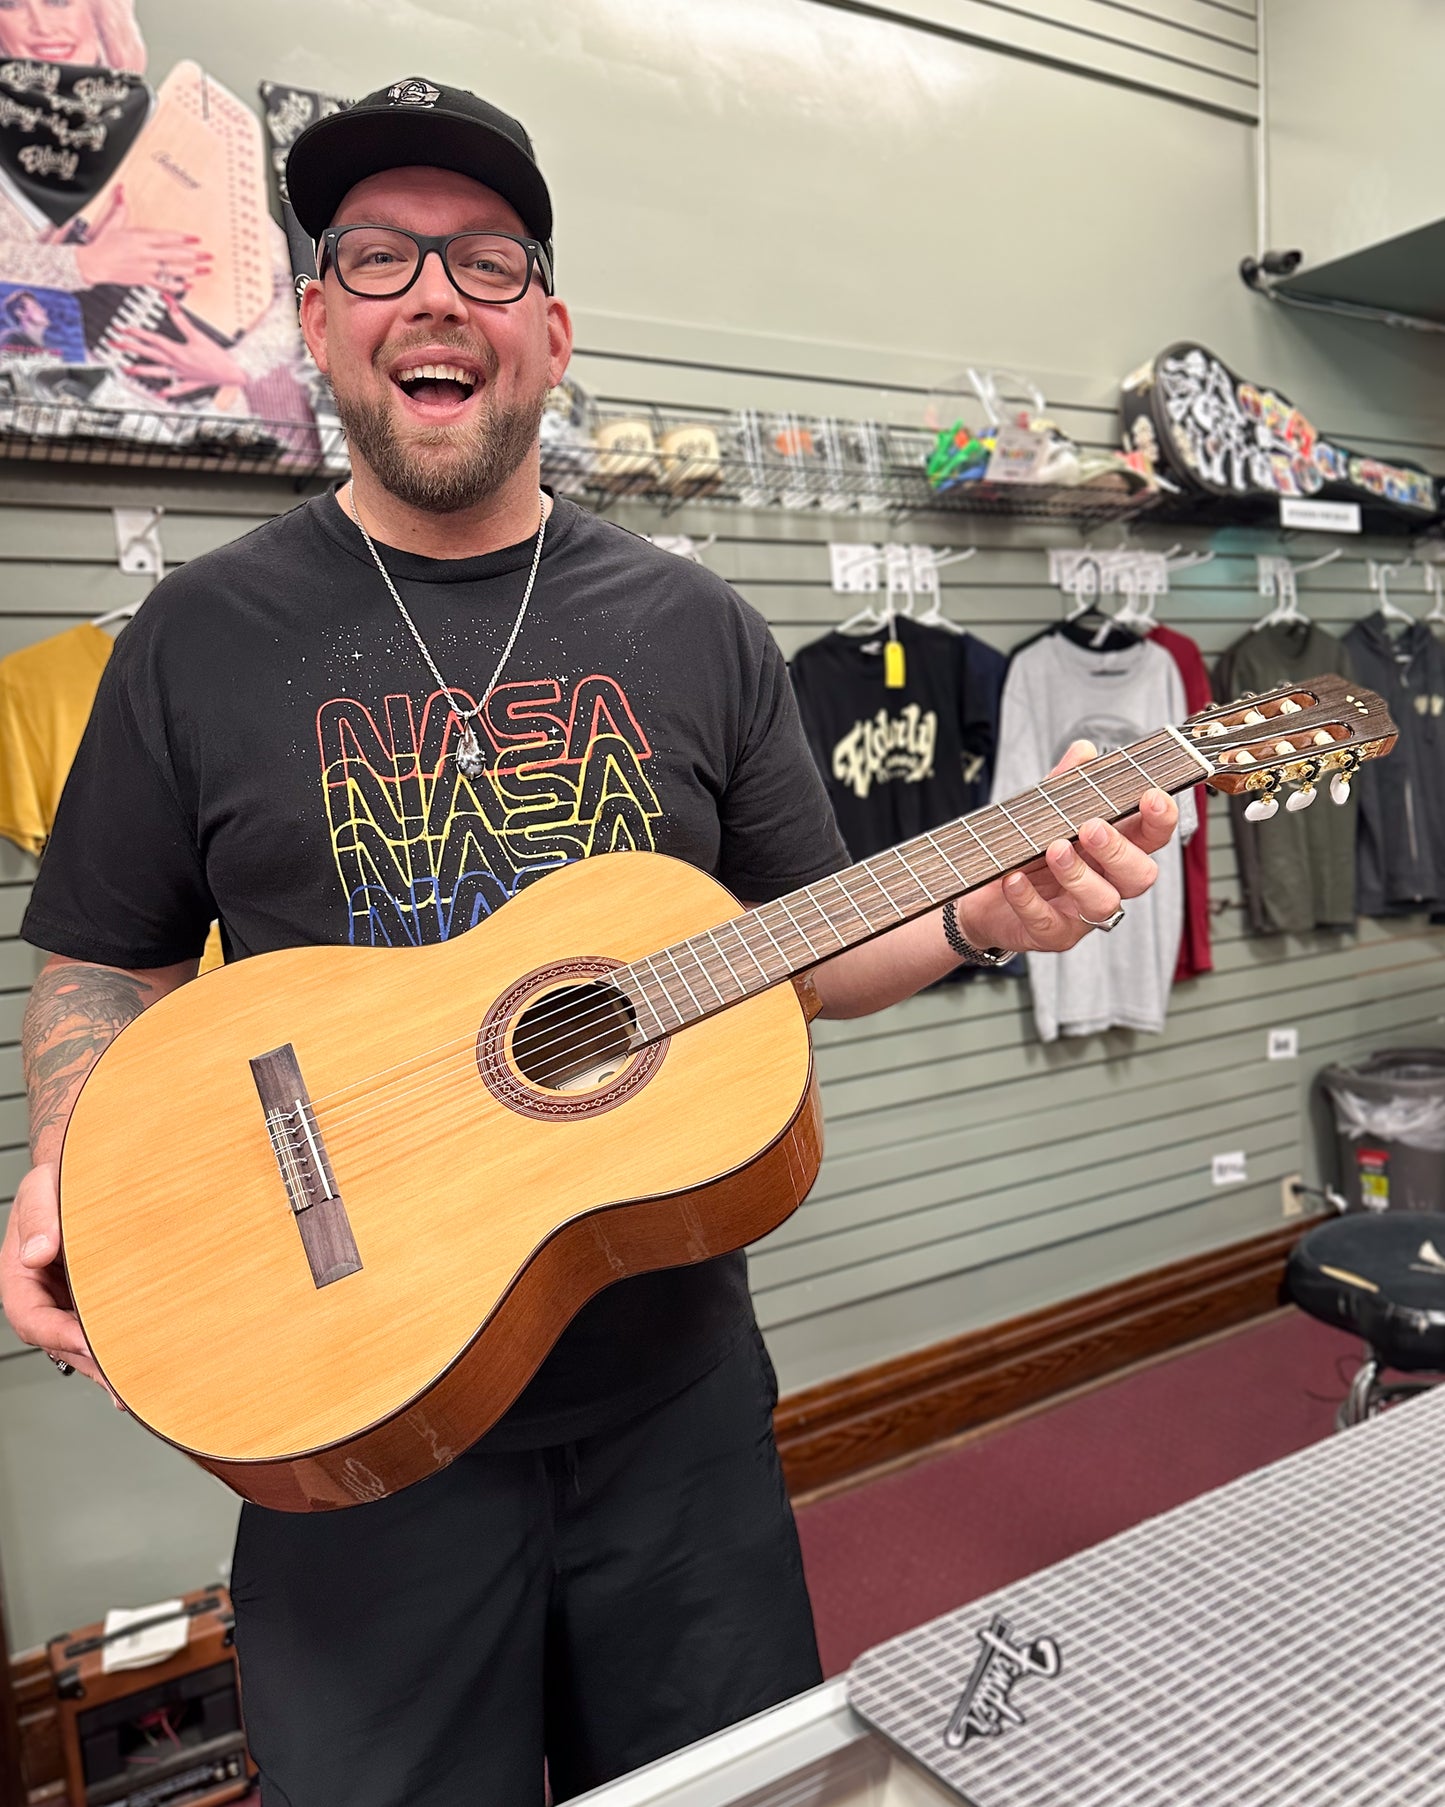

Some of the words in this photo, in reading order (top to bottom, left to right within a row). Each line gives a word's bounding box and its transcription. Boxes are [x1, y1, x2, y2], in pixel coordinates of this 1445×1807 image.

[315, 673, 652, 789] NASA
[322, 733, 664, 853] NASA
[944, 1614, 1062, 1750] Fender
